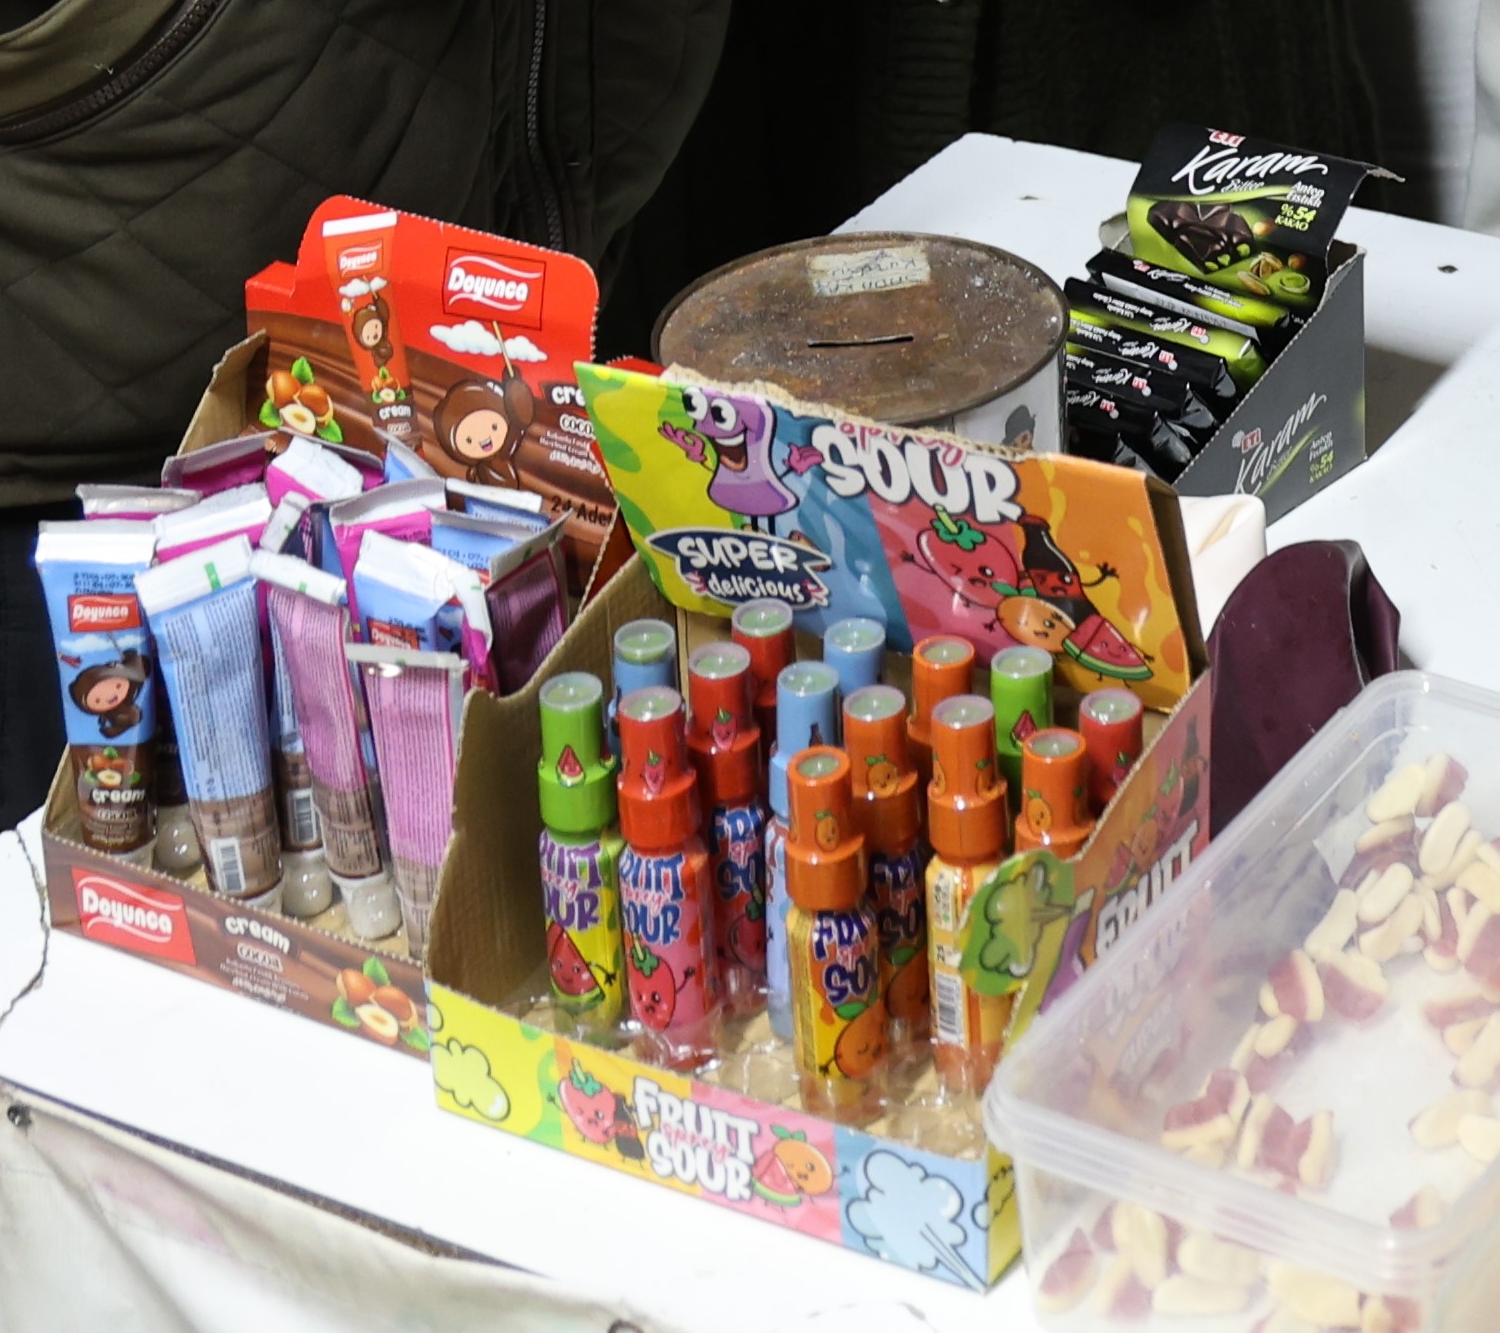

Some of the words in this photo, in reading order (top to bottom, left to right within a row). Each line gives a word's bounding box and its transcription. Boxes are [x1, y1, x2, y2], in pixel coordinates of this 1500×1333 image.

[1171, 145, 1330, 196] Karam
[1220, 178, 1266, 195] Bitter
[1291, 181, 1326, 200] Antep
[1274, 215, 1310, 232] KAKAO
[1279, 203, 1318, 224] %54
[447, 265, 530, 305] Doyunca
[377, 403, 415, 420] cream
[551, 386, 586, 409] cre
[814, 423, 1026, 526] SOUR
[576, 499, 614, 526] Adet
[674, 534, 804, 575] SUPER
[706, 567, 808, 606] delicious
[71, 602, 130, 623] Doyunca
[91, 788, 146, 804] cream
[81, 887, 175, 937] Doyunca
[224, 915, 292, 956] cream
[631, 1076, 760, 1157] FRUIT
[647, 1134, 754, 1204] SOUR
